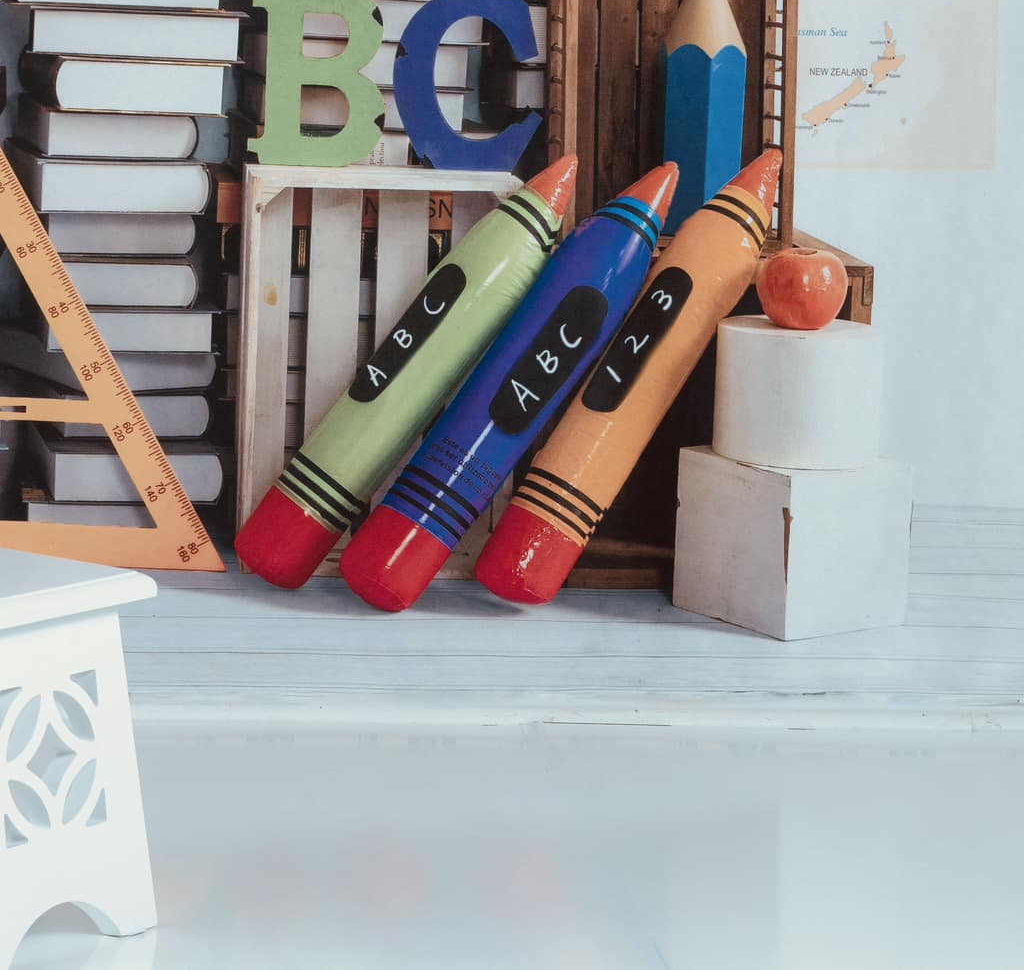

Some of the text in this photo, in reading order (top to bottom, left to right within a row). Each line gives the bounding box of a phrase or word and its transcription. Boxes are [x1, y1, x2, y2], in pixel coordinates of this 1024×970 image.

[809, 68, 868, 76] NEW ZEALAND
[16, 246, 27, 258] 60
[26, 241, 37, 253] 30
[48, 306, 59, 318] 80
[59, 302, 69, 313] 40
[80, 365, 93, 381] 100
[90, 361, 101, 373] 50
[112, 424, 125, 442] 120
[122, 421, 133, 434] 60
[144, 485, 158, 502] 140
[155, 482, 166, 494] 70
[177, 546, 190, 562] 160
[187, 543, 199, 555] 80
